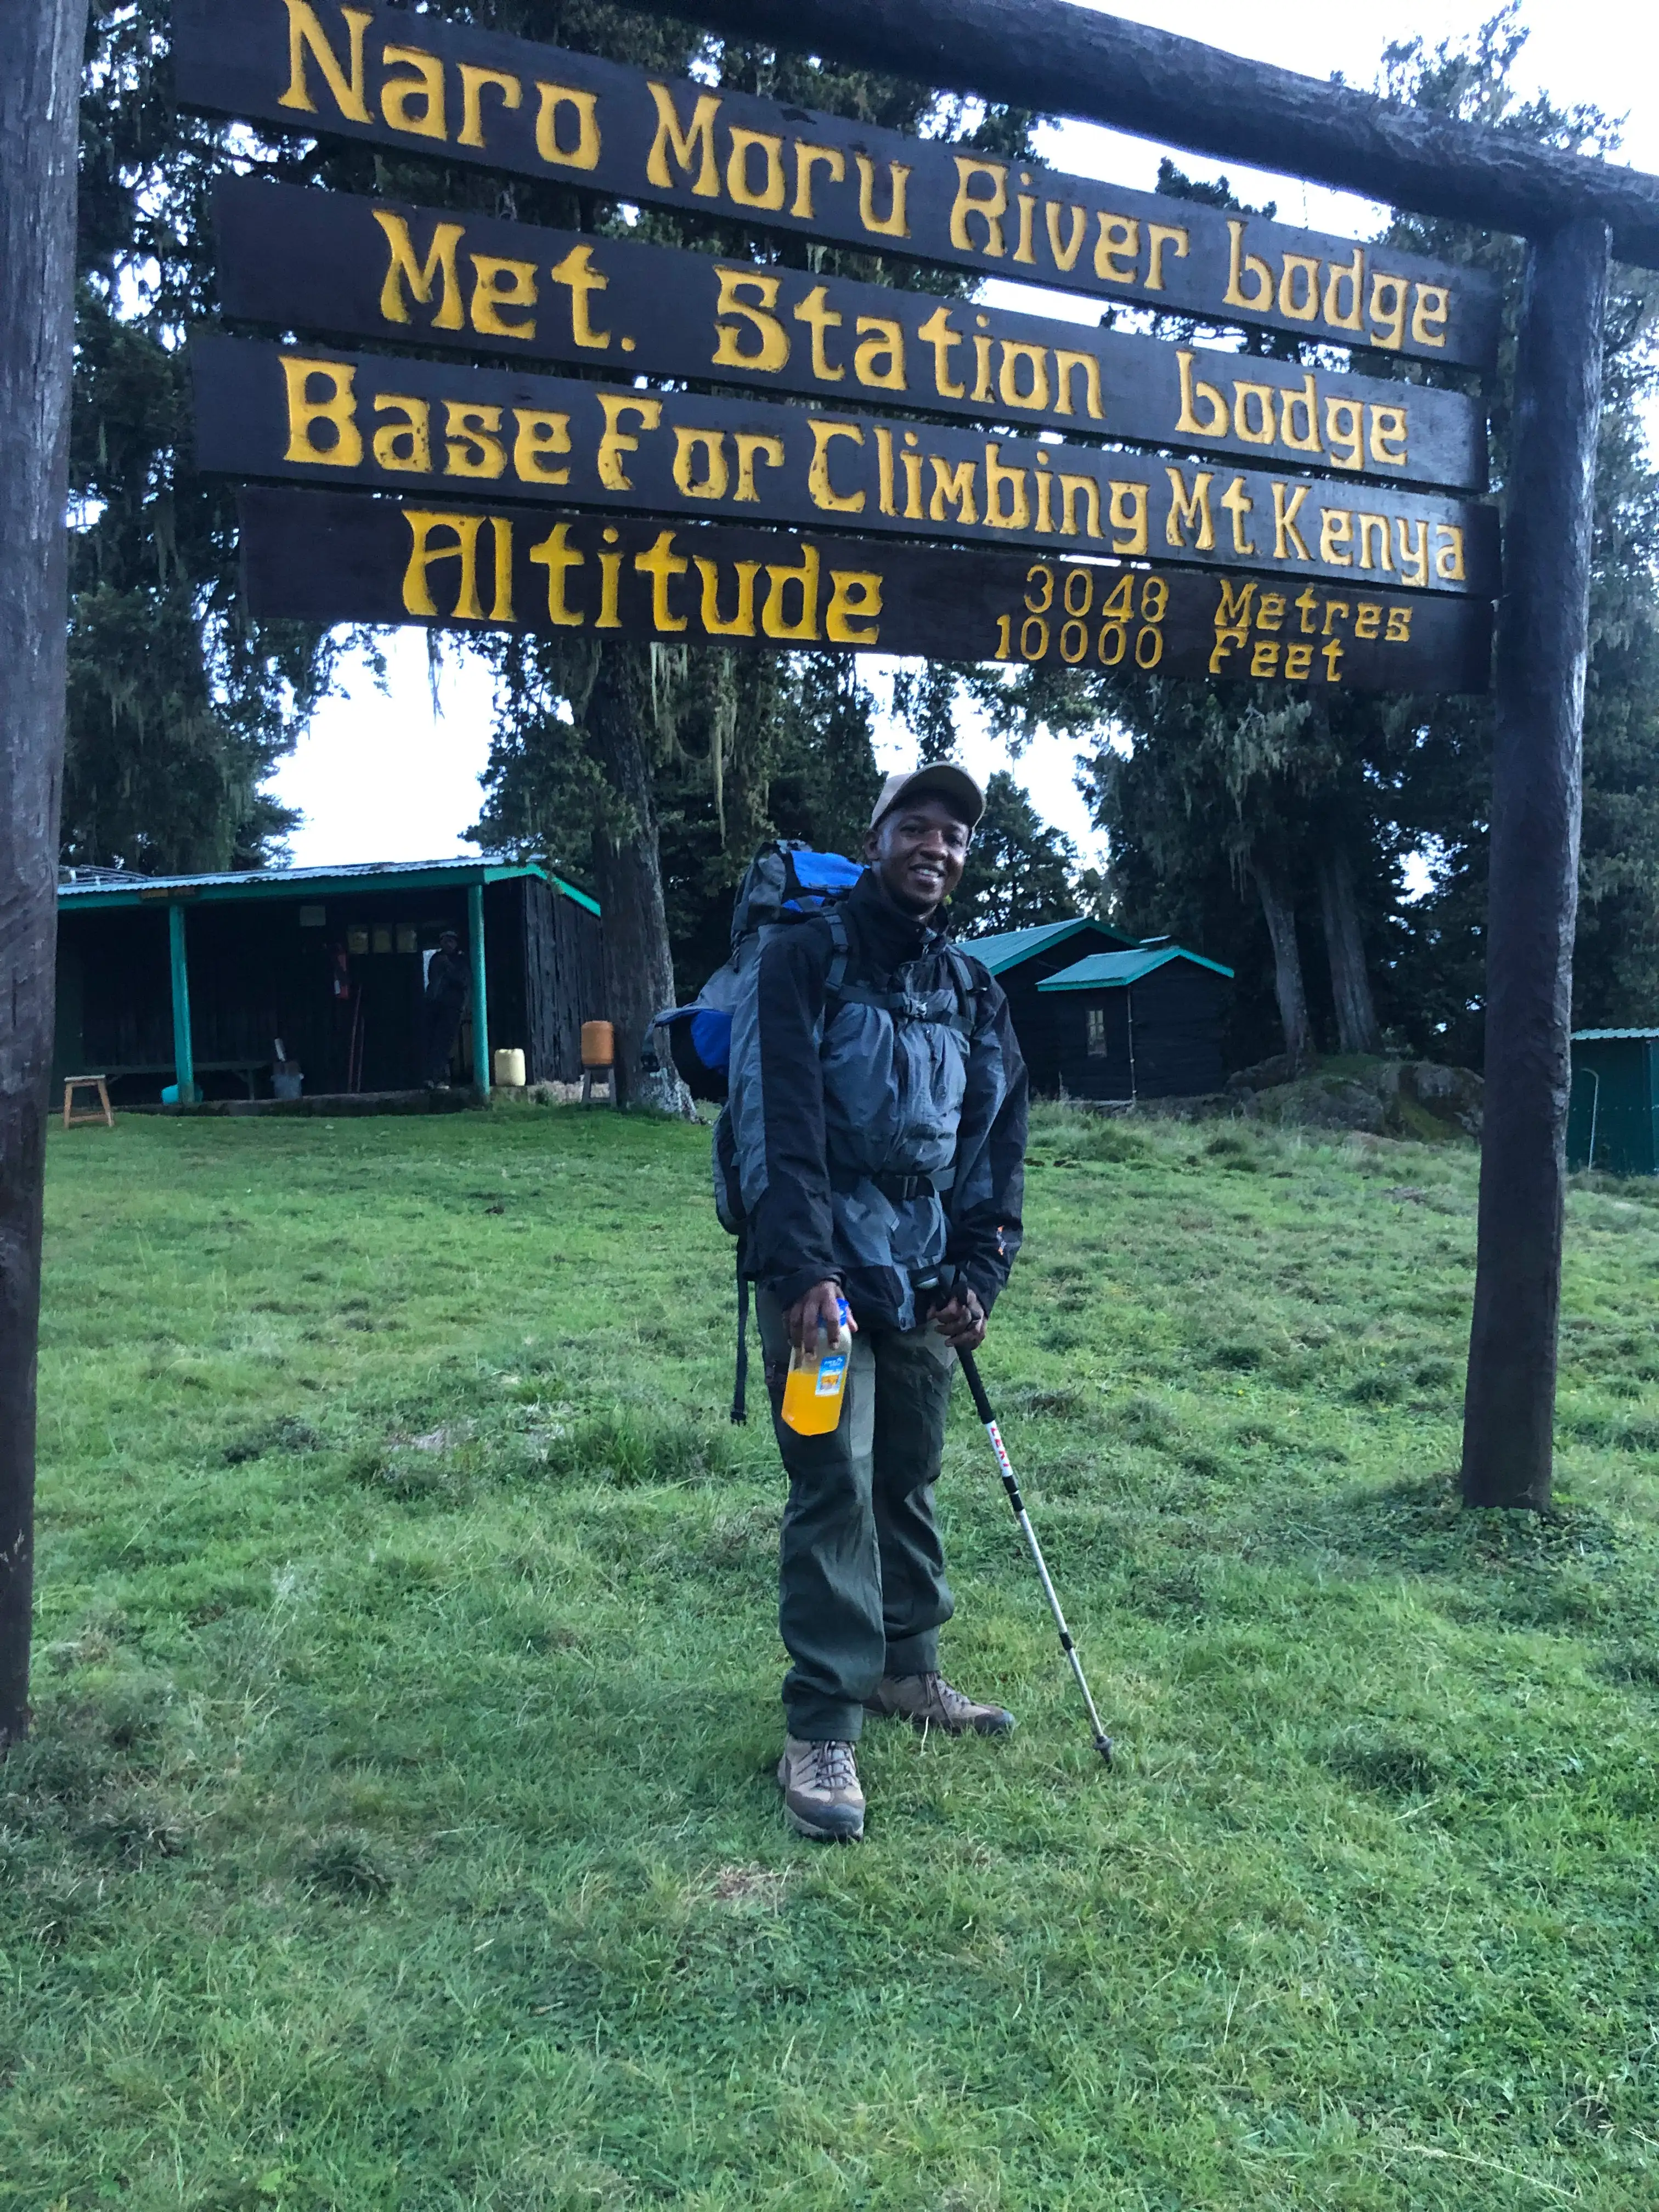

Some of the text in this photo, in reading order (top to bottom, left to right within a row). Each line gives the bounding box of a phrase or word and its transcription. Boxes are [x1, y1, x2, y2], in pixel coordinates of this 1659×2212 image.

[277, 0, 1449, 350] Naro Moru River Lodge
[371, 208, 1409, 471] Met. Station Lodge
[279, 354, 572, 485] Base
[596, 392, 785, 503] For
[808, 418, 1150, 555] Climbing
[1271, 481, 1466, 586] Kenya
[402, 509, 883, 645] Altitude
[995, 614, 1345, 682] 10000 Feet
[1025, 564, 1413, 643] 3048 Metres
